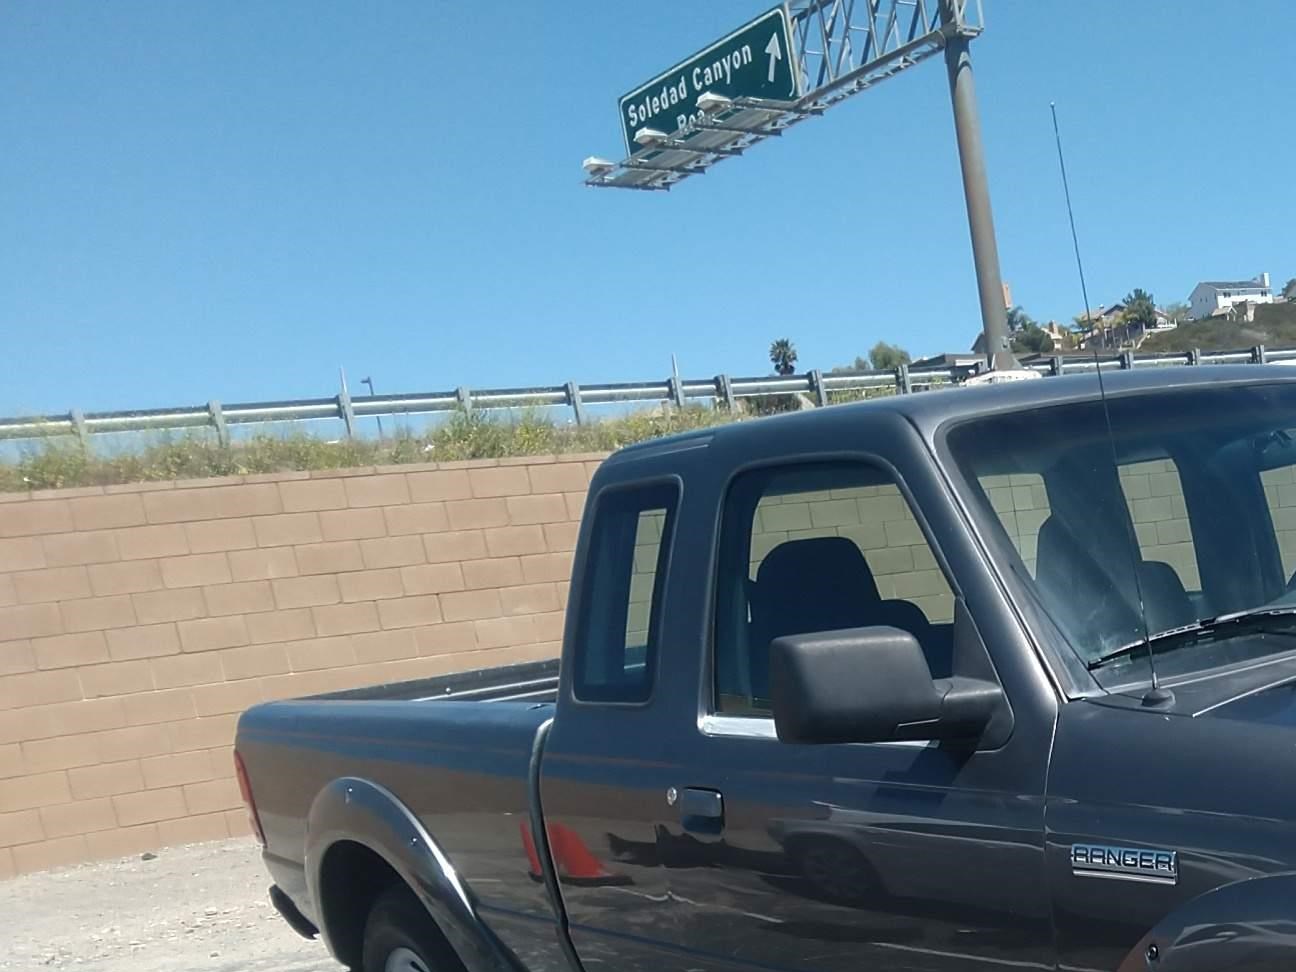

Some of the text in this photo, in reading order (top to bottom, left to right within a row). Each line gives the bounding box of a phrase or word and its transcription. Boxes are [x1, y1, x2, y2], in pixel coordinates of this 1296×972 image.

[628, 44, 753, 127] Soledad Canyon
[1072, 845, 1174, 871] RANGER
